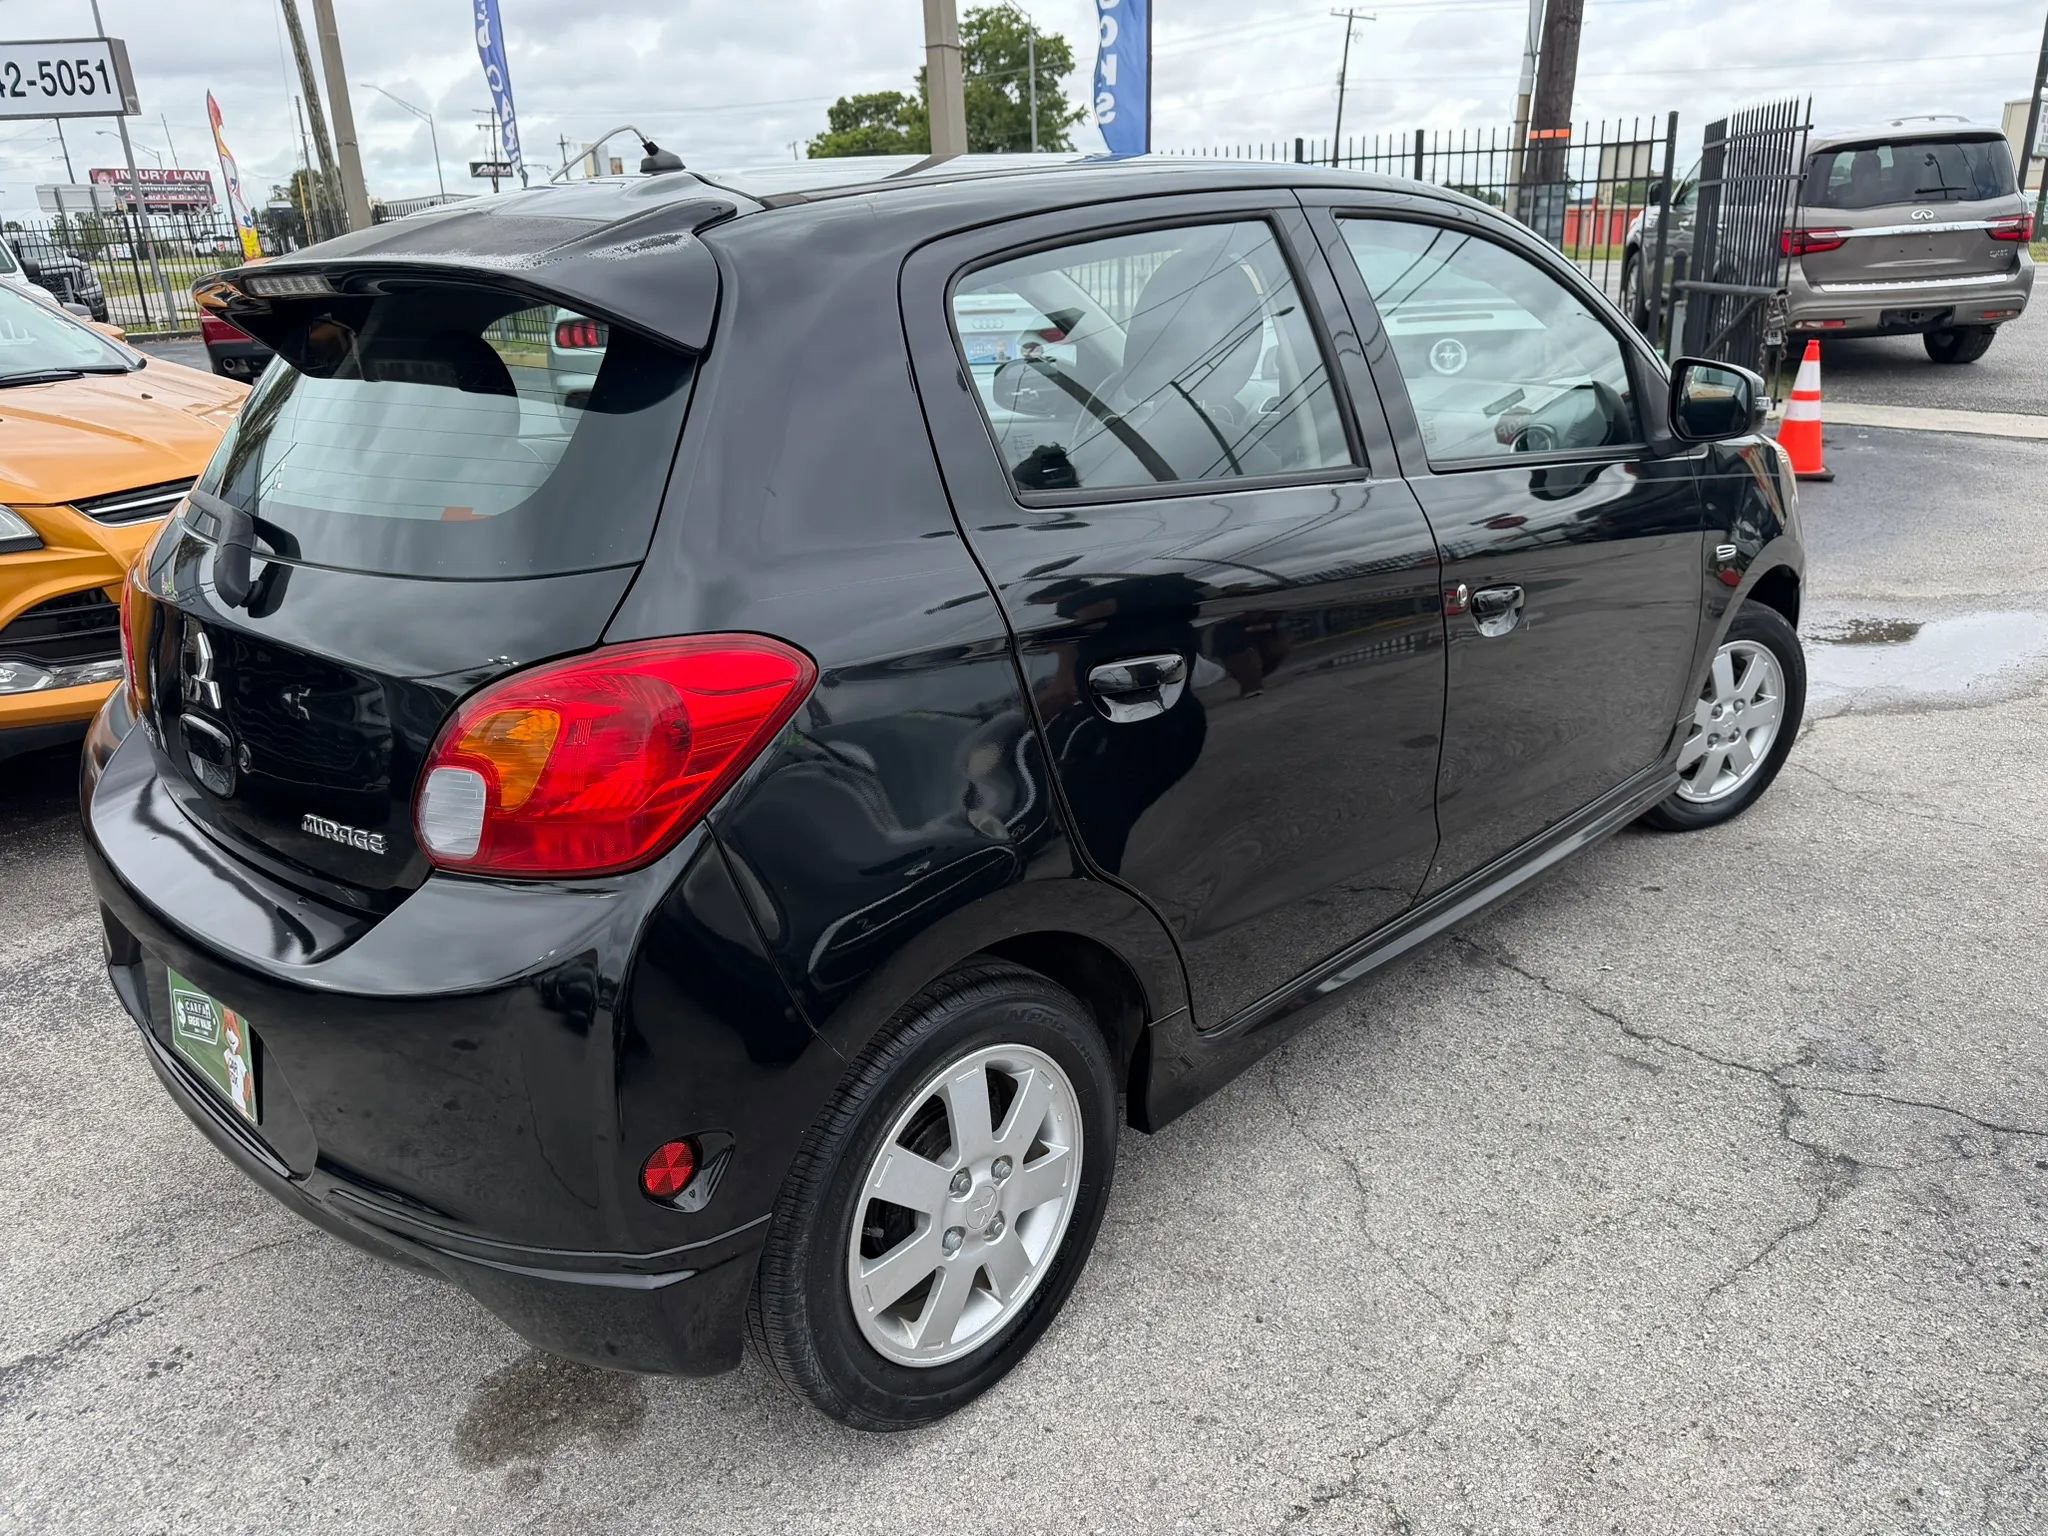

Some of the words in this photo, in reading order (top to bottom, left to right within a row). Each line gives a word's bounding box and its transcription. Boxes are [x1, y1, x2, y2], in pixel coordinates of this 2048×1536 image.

[115, 170, 168, 181] INURY
[173, 170, 206, 181] LAW
[302, 814, 387, 854] MIRAGE
